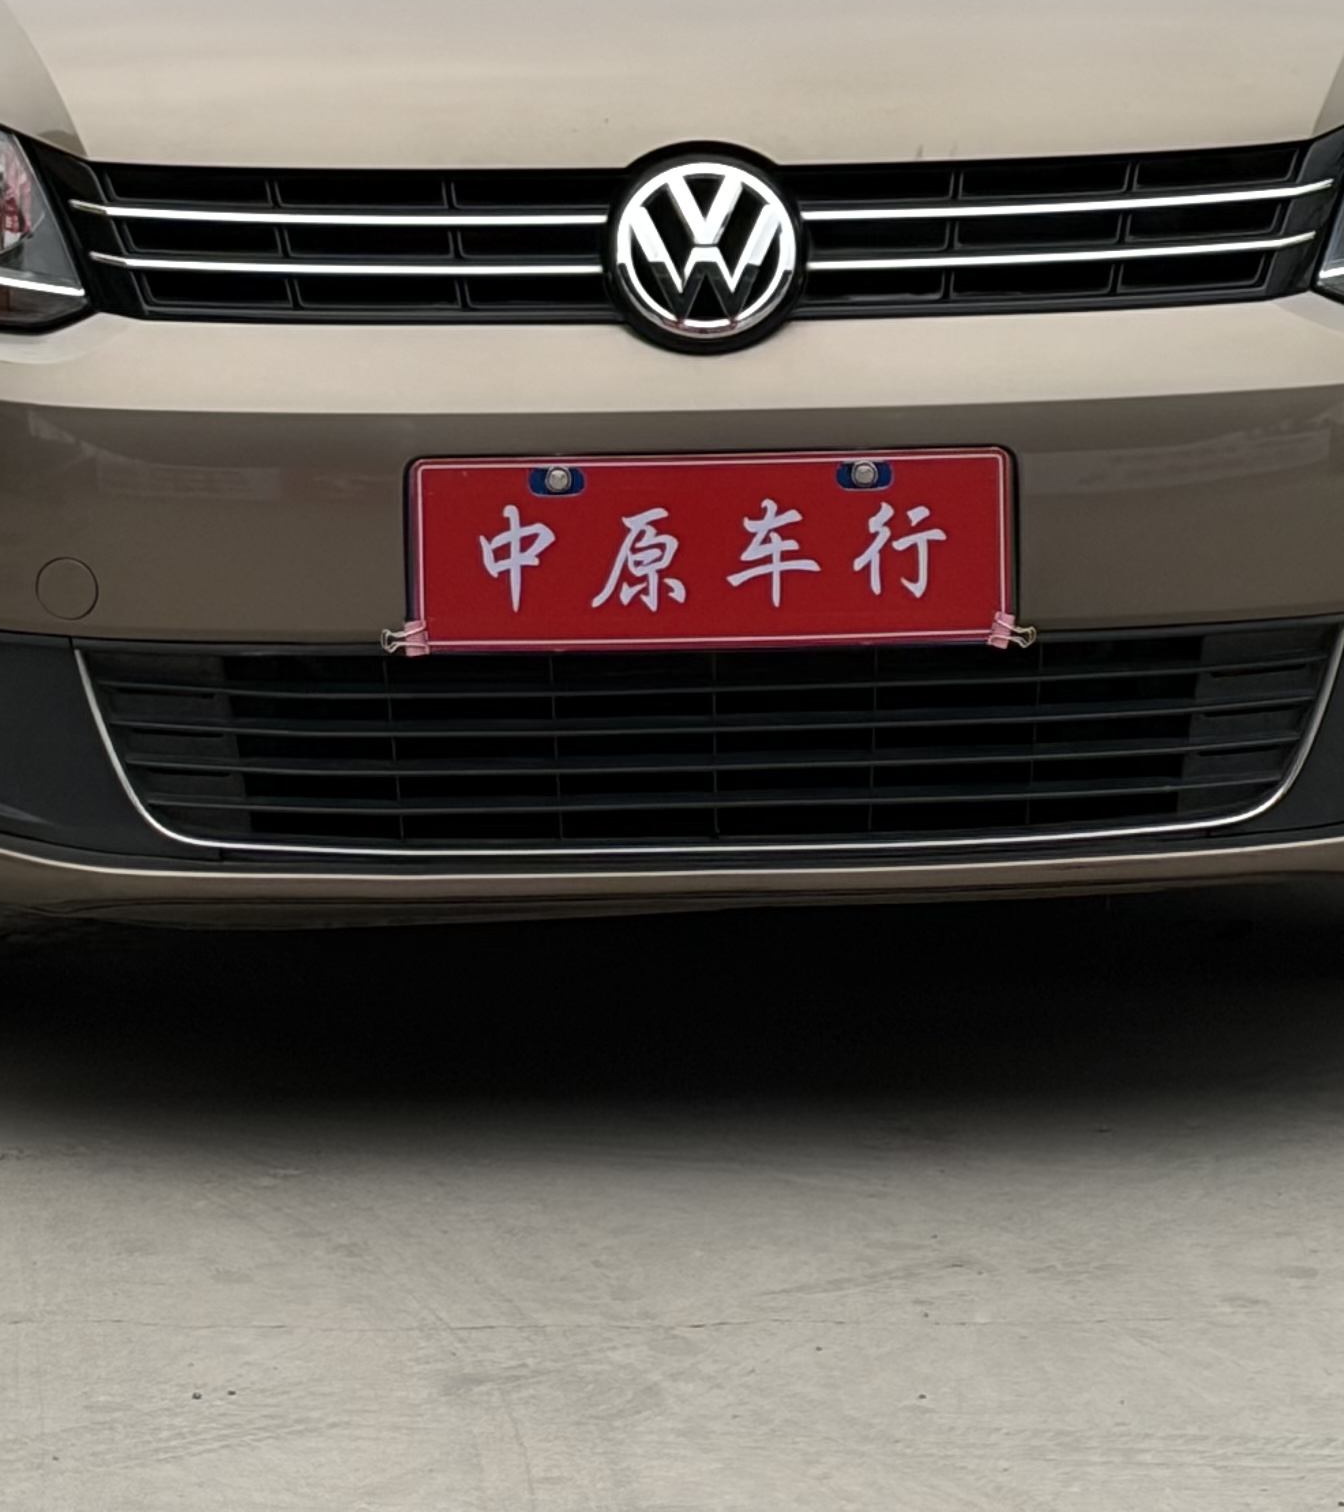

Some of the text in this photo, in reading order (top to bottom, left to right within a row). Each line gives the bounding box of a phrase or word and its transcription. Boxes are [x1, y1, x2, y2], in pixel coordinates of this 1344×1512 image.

[619, 164, 794, 336] VW
[478, 498, 947, 612] 中原车行
